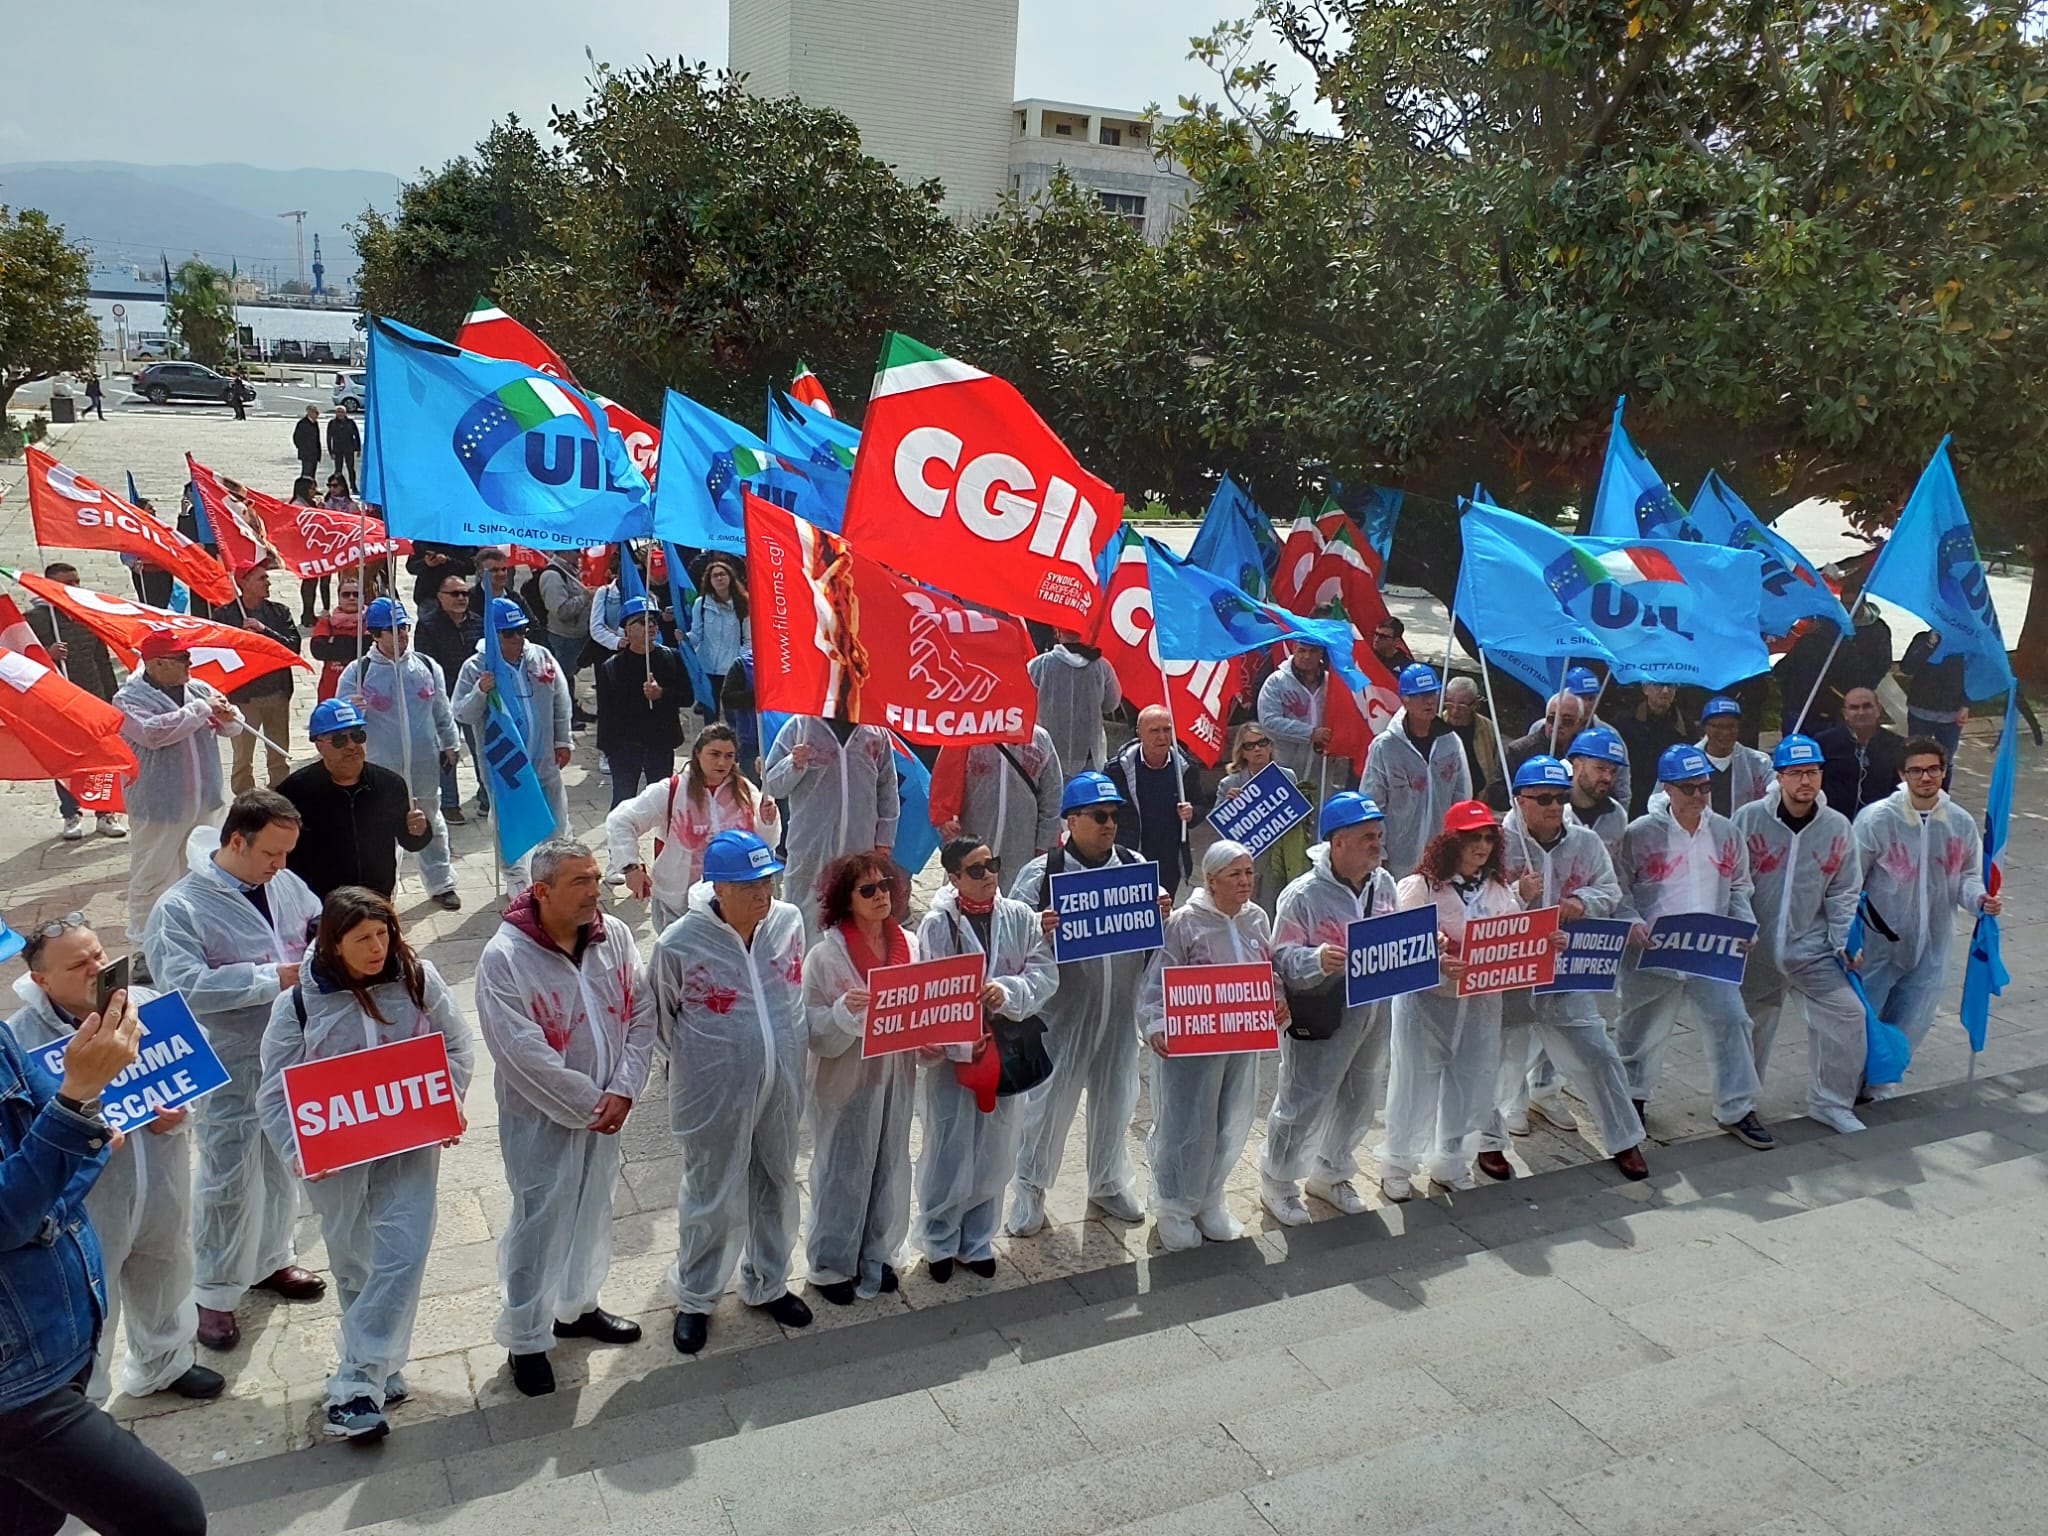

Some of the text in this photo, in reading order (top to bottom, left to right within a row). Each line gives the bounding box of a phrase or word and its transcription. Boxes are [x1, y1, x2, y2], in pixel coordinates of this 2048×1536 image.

[894, 426, 1098, 587] CGIL
[463, 522, 475, 533] IL
[478, 523, 549, 540] SINDACATO
[552, 532, 572, 544] DEI
[718, 533, 746, 544] SINDAC
[299, 540, 400, 577] FILCAMS
[761, 535, 792, 674] www.filcams.cgil
[1039, 589, 1065, 604] TRADE
[1639, 663, 1700, 673] CITTADINI
[886, 703, 1023, 736] FILCAMS
[1215, 783, 1261, 826] NUOVO
[1228, 786, 1290, 840] MODELLO
[1243, 805, 1298, 854] SOCIALE
[1060, 883, 1153, 914] ZERO MORTI
[1062, 909, 1155, 941] SUL LAVORO
[1471, 916, 1530, 941] NUOVO
[1351, 932, 1436, 978] SICUREZZA
[1468, 938, 1548, 966] MODELLO
[1572, 933, 1624, 952] MODELLO
[1648, 931, 1745, 958] SALUTE
[1465, 964, 1537, 990] SOCIALE
[1569, 957, 1617, 975] IMPRESA
[875, 974, 976, 1010] ZERO MORTI
[1169, 981, 1271, 1007] NUOVO MODELLO
[872, 1001, 974, 1036] SUL LAVORO
[1168, 1010, 1277, 1036] DI FARE IMPRESA
[296, 1069, 451, 1137] SALUTE
